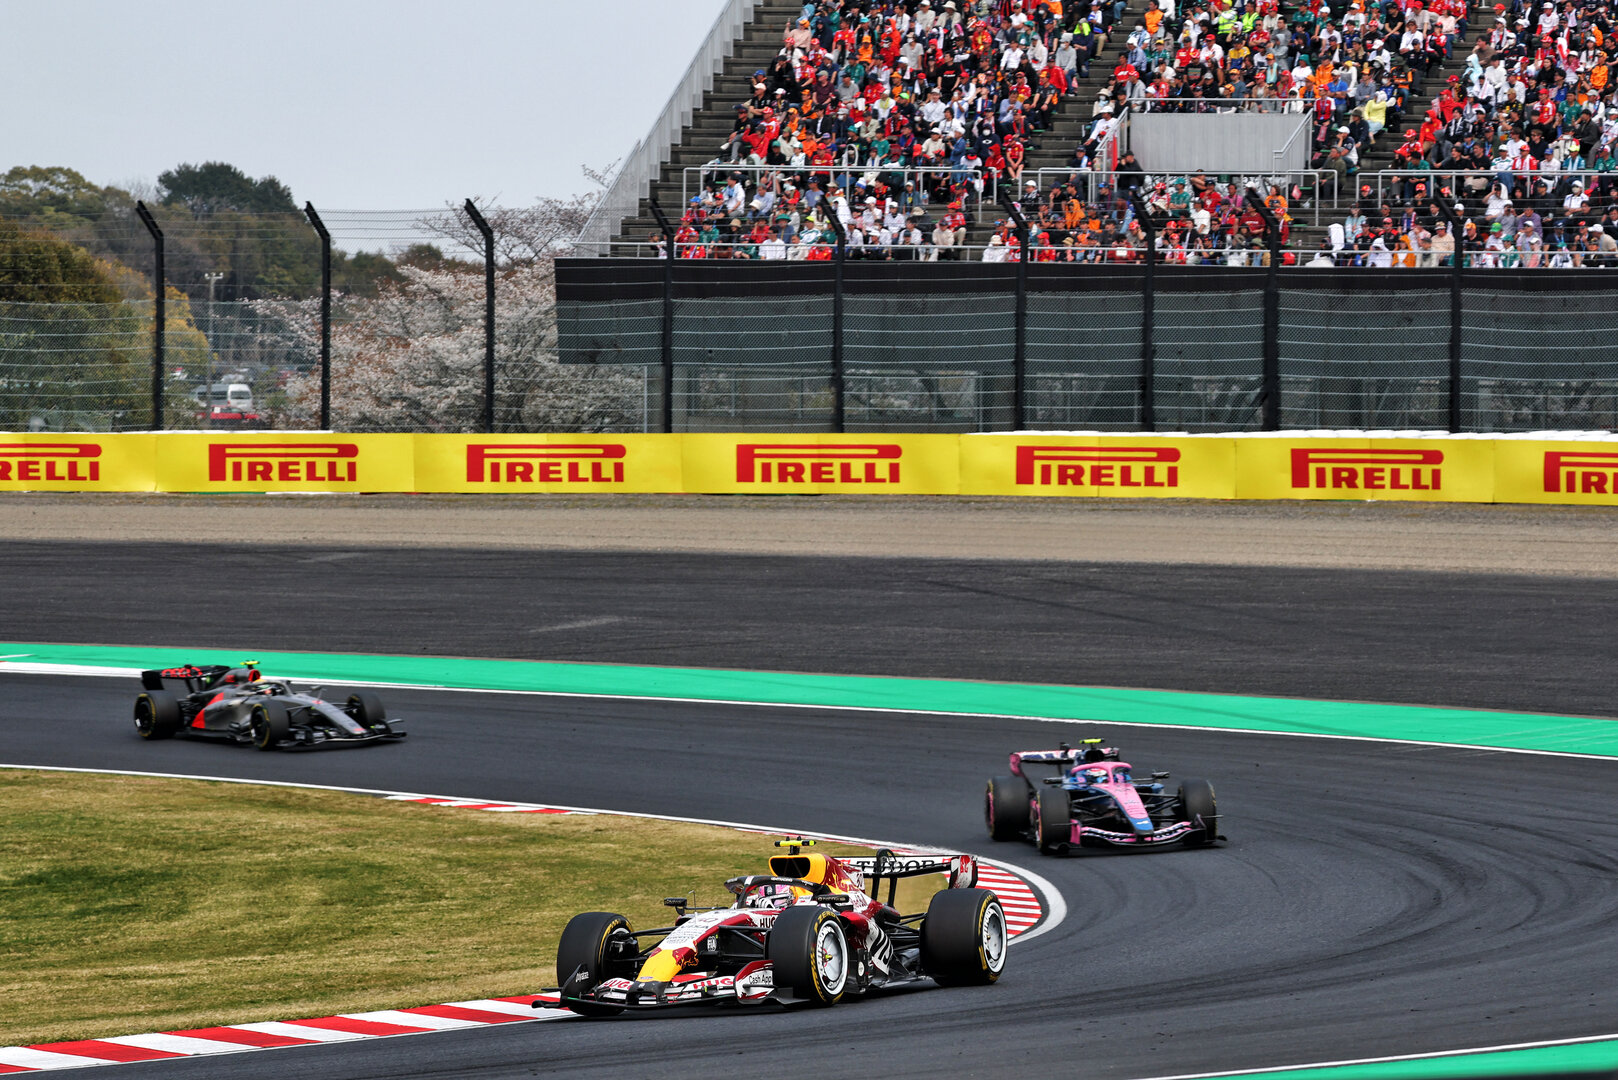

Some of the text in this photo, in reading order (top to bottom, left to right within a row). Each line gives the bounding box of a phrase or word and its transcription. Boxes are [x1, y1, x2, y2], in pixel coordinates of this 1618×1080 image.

[0, 443, 102, 481] RELLI
[208, 443, 359, 482] PIRELLI
[466, 444, 627, 483] PIRELLI
[736, 444, 903, 483] PIRELLI
[1015, 445, 1181, 487] PIRELLI
[1290, 448, 1444, 490] PIRELLI
[1543, 451, 1618, 494] PIR
[693, 978, 734, 990] HUG
[749, 974, 773, 986] Cash App
